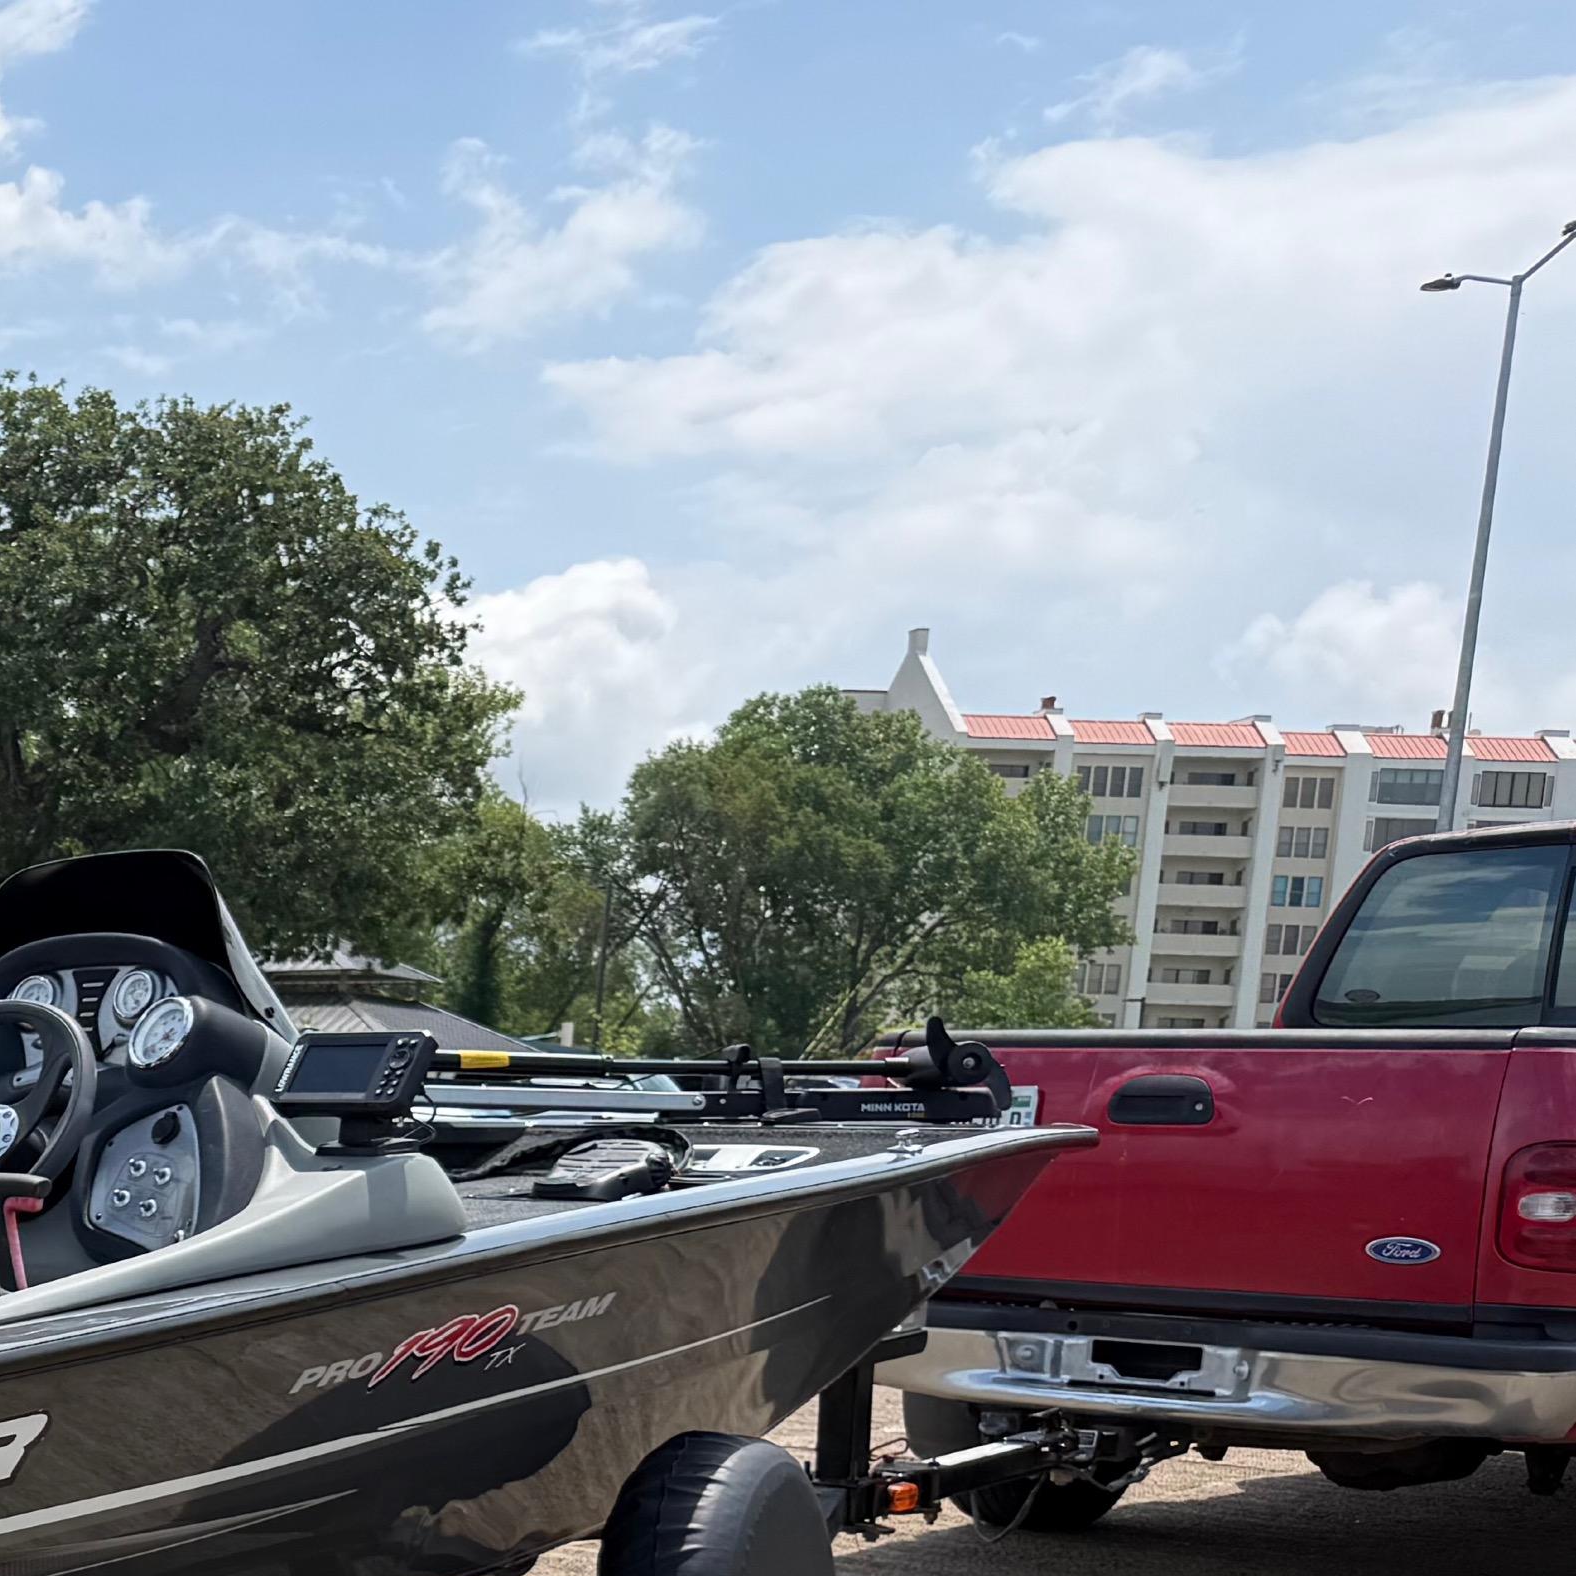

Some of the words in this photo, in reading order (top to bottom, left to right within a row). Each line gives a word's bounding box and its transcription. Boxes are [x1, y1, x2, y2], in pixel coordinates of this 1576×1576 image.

[861, 1103, 892, 1113] MINN
[894, 1103, 926, 1113] KOTA
[1382, 1242, 1423, 1258] Ford
[289, 1352, 383, 1394] PRO
[367, 1304, 519, 1389] 190
[516, 1292, 617, 1336] TEAM
[484, 1343, 526, 1371] TX
